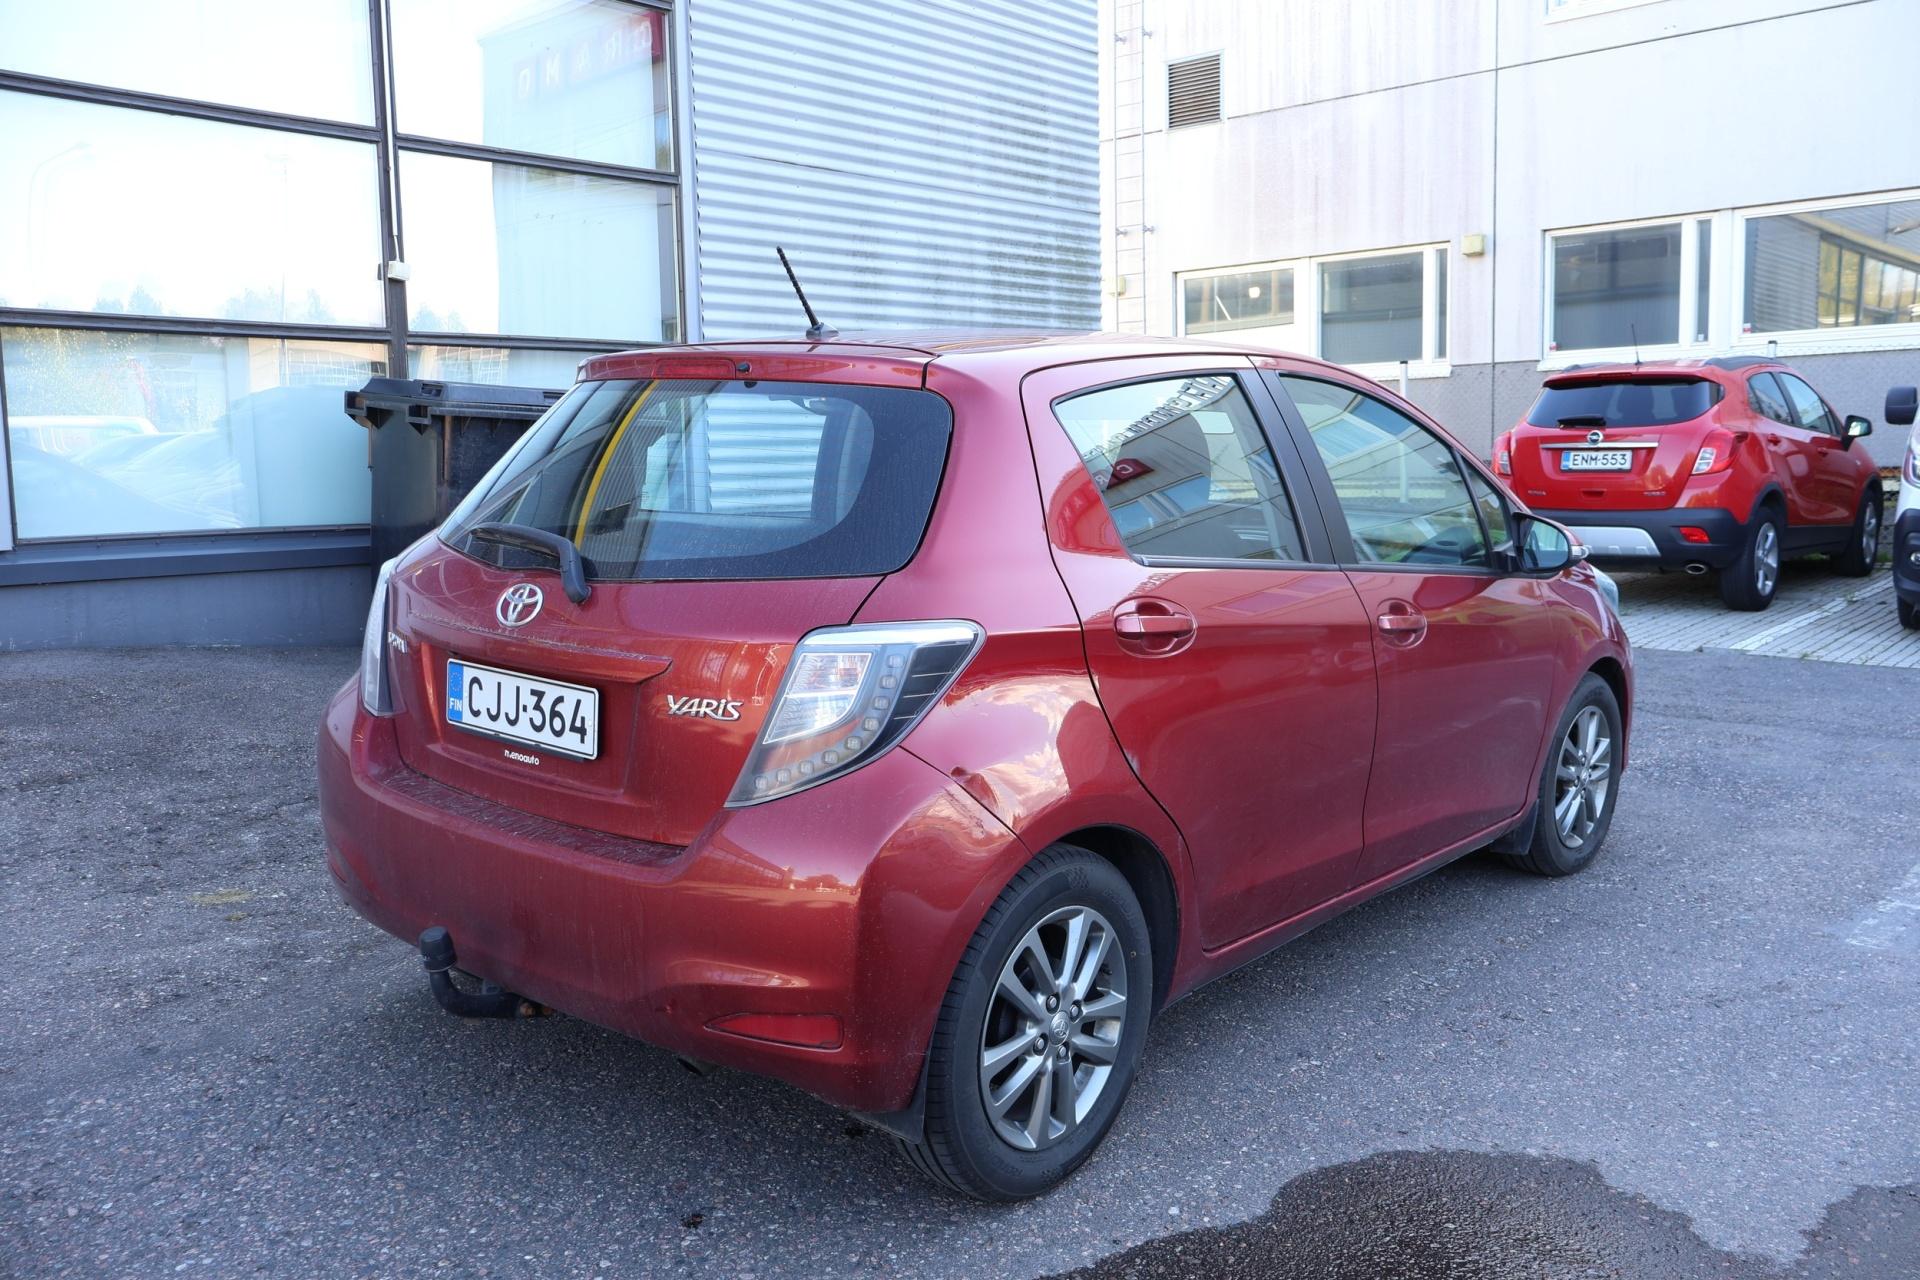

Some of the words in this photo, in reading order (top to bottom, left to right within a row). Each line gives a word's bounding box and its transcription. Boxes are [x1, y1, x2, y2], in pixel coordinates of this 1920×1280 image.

[1572, 453, 1627, 466] ENM-553
[449, 697, 463, 711] FIN
[468, 676, 587, 744] CJJ-364
[667, 694, 744, 720] YARIS
